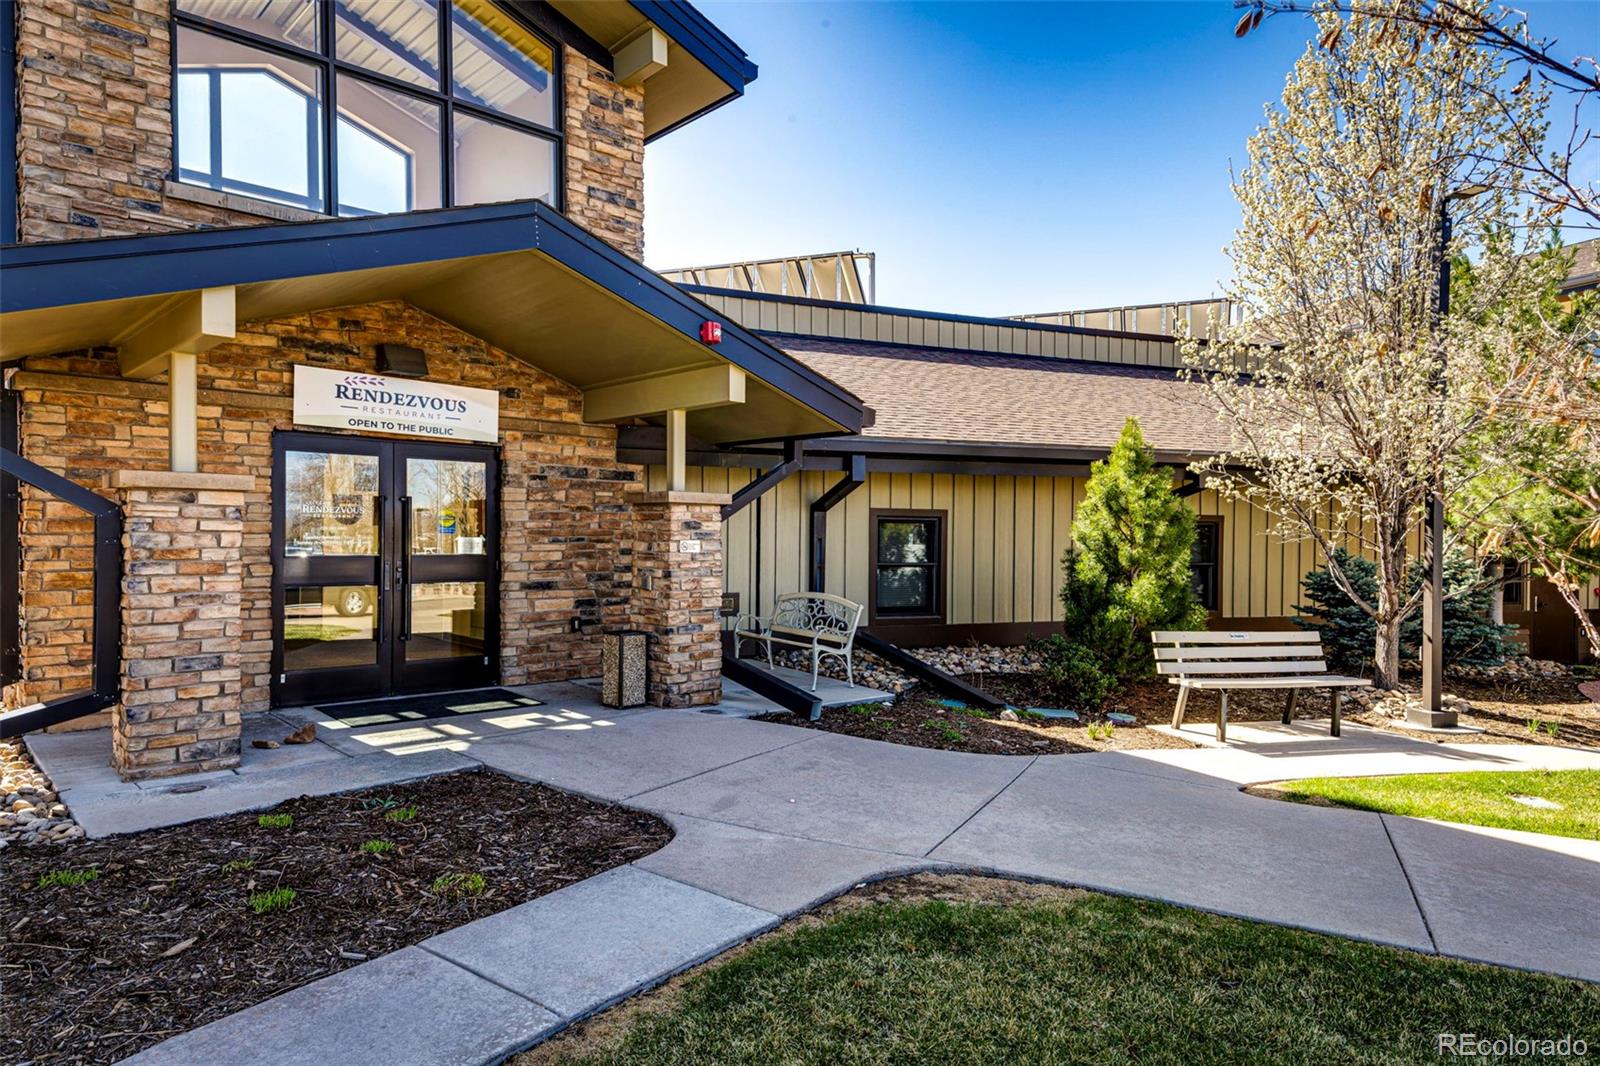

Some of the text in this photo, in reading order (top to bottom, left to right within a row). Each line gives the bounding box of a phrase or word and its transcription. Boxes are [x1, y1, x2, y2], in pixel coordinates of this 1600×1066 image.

[335, 384, 467, 413] RENDEZVOUS
[362, 405, 442, 421] RESTAURANT
[348, 418, 454, 436] OPEN TO THE PUBLIC
[302, 504, 365, 514] RENDEZVOUS
